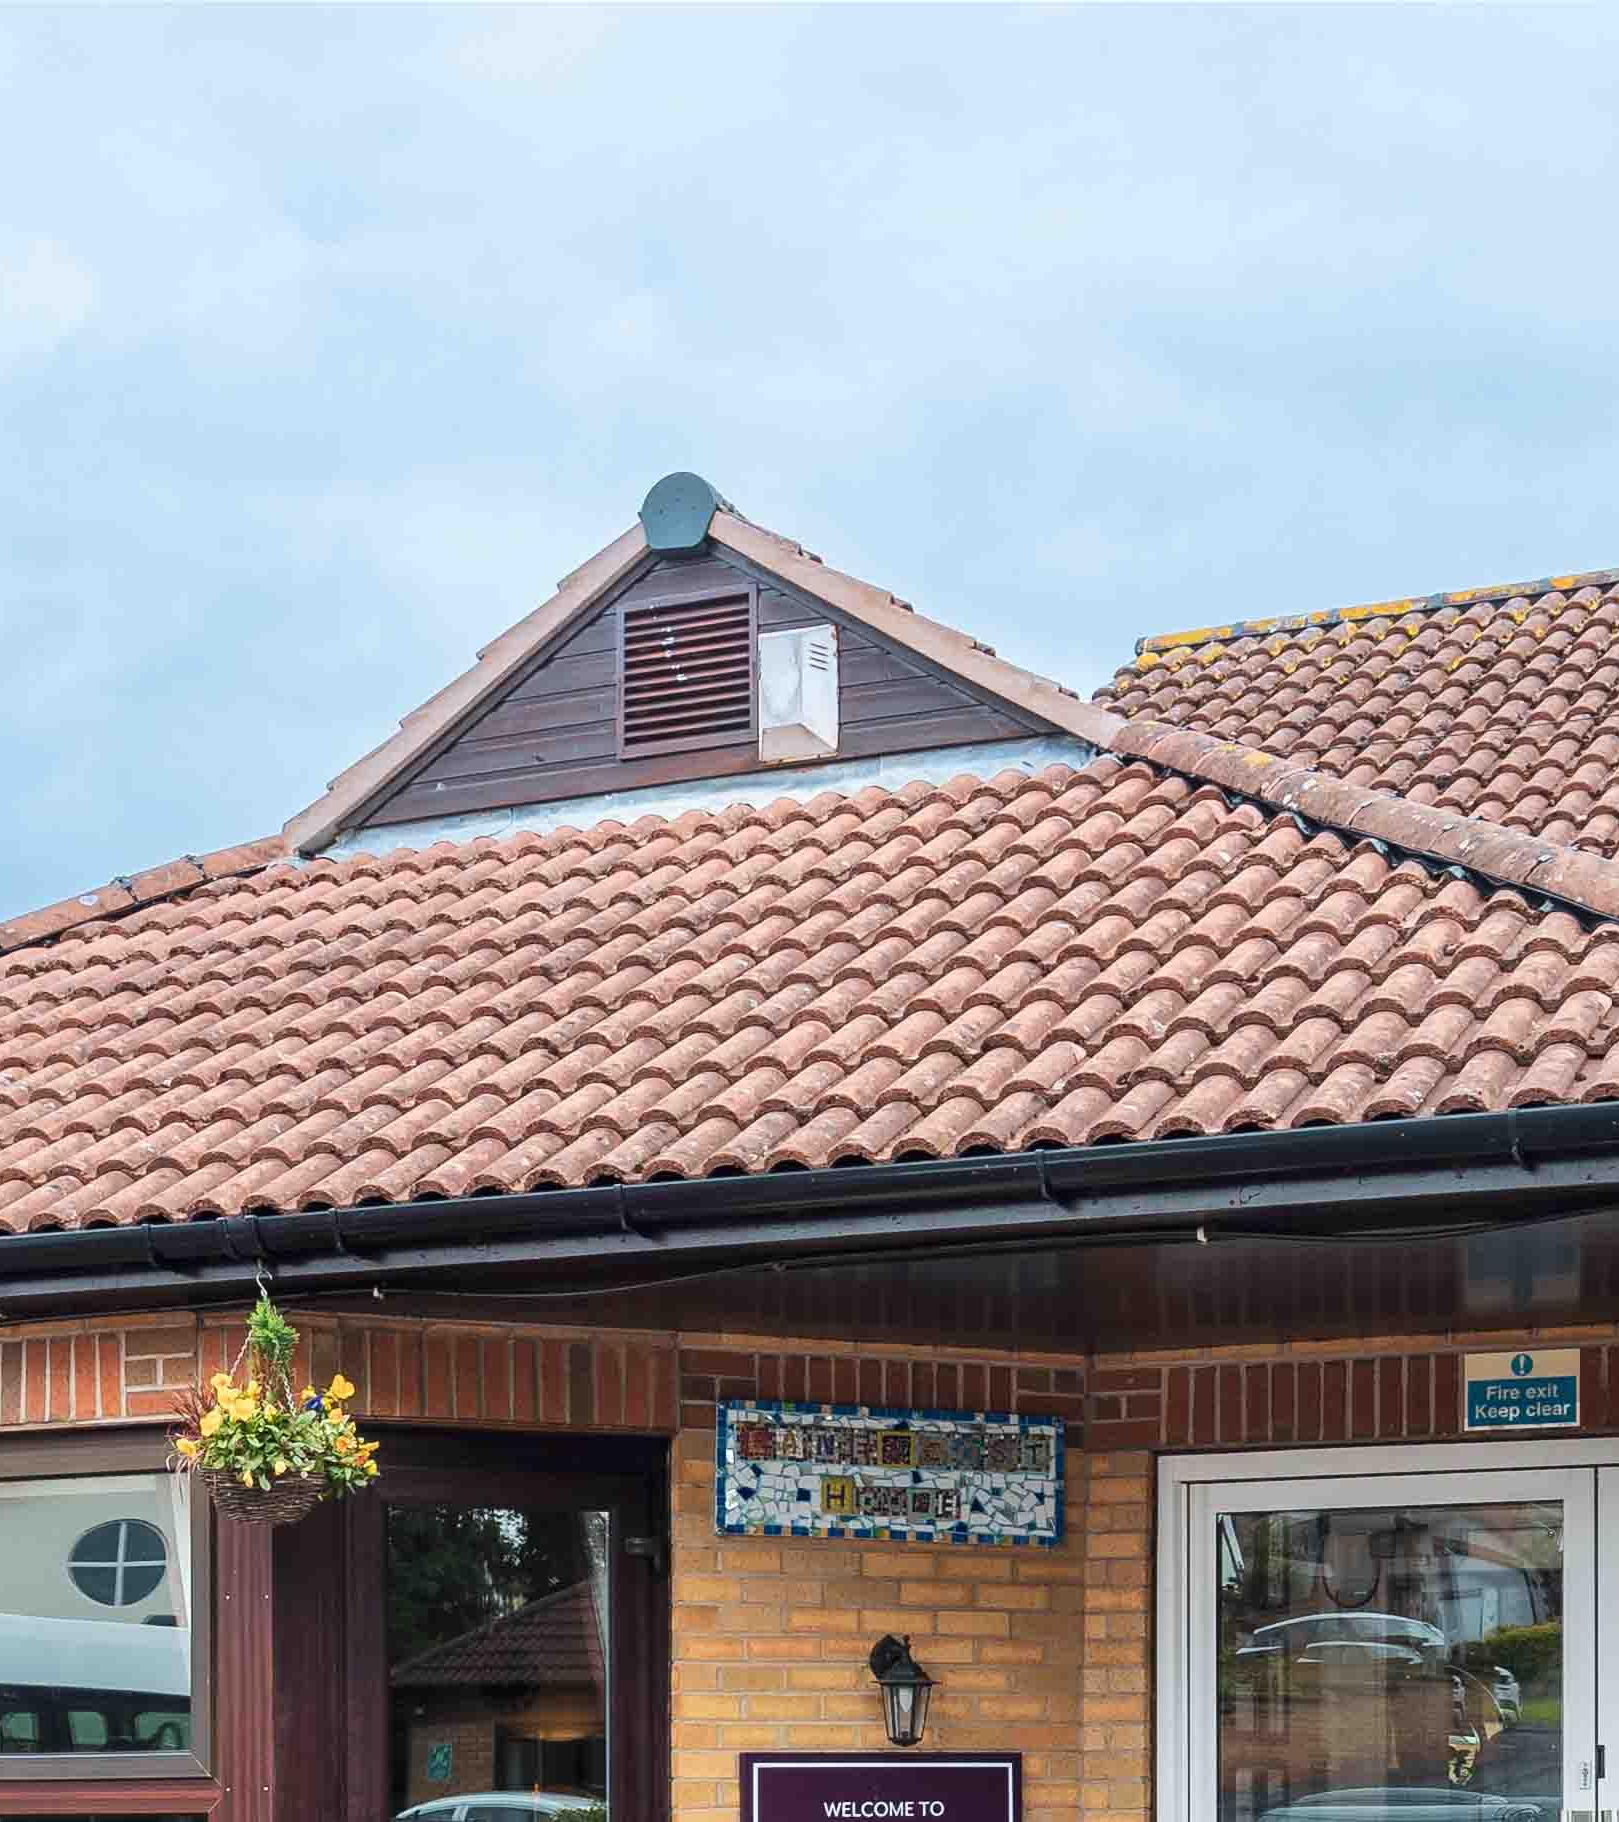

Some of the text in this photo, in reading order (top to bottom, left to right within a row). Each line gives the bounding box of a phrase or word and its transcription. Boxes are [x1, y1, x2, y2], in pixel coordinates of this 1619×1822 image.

[1486, 1383, 1559, 1401] Fire exit
[1475, 1402, 1571, 1421] Keep clear
[824, 1801, 945, 1818] WELCOME TO
